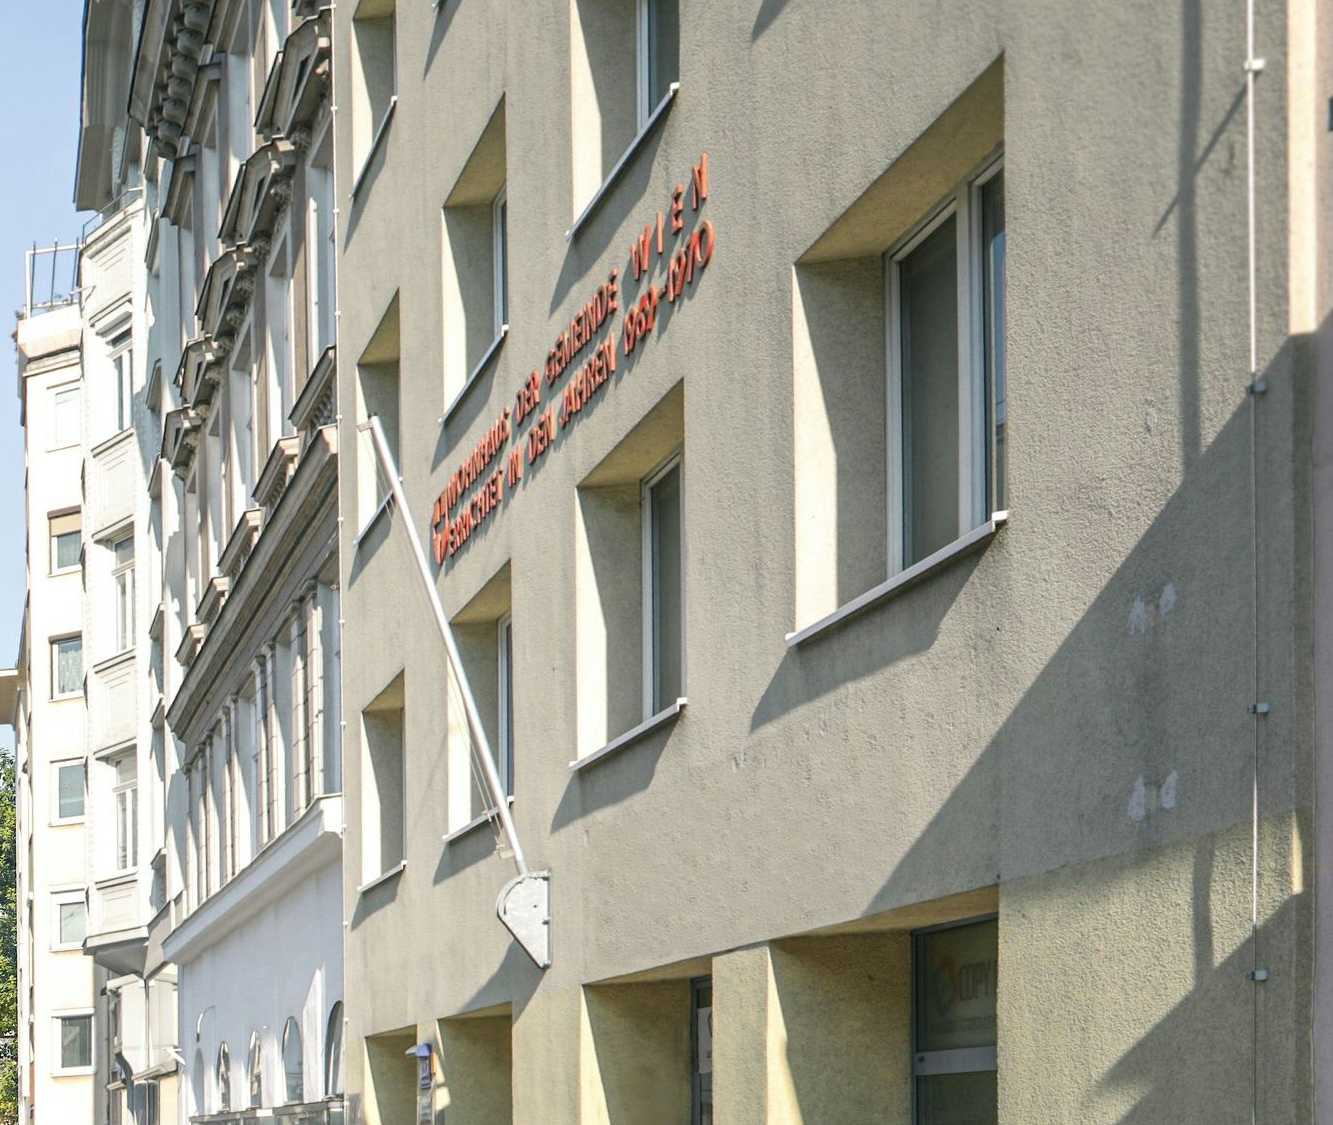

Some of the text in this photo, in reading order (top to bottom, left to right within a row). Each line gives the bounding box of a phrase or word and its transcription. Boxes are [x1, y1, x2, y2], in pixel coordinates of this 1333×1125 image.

[448, 152, 709, 510] WOHNHAUS DER GEMEINDE WIEN
[450, 465, 503, 556] ERRICHTET
[508, 443, 524, 488] IN
[528, 405, 557, 465] DEN
[560, 331, 617, 427] JAHREN
